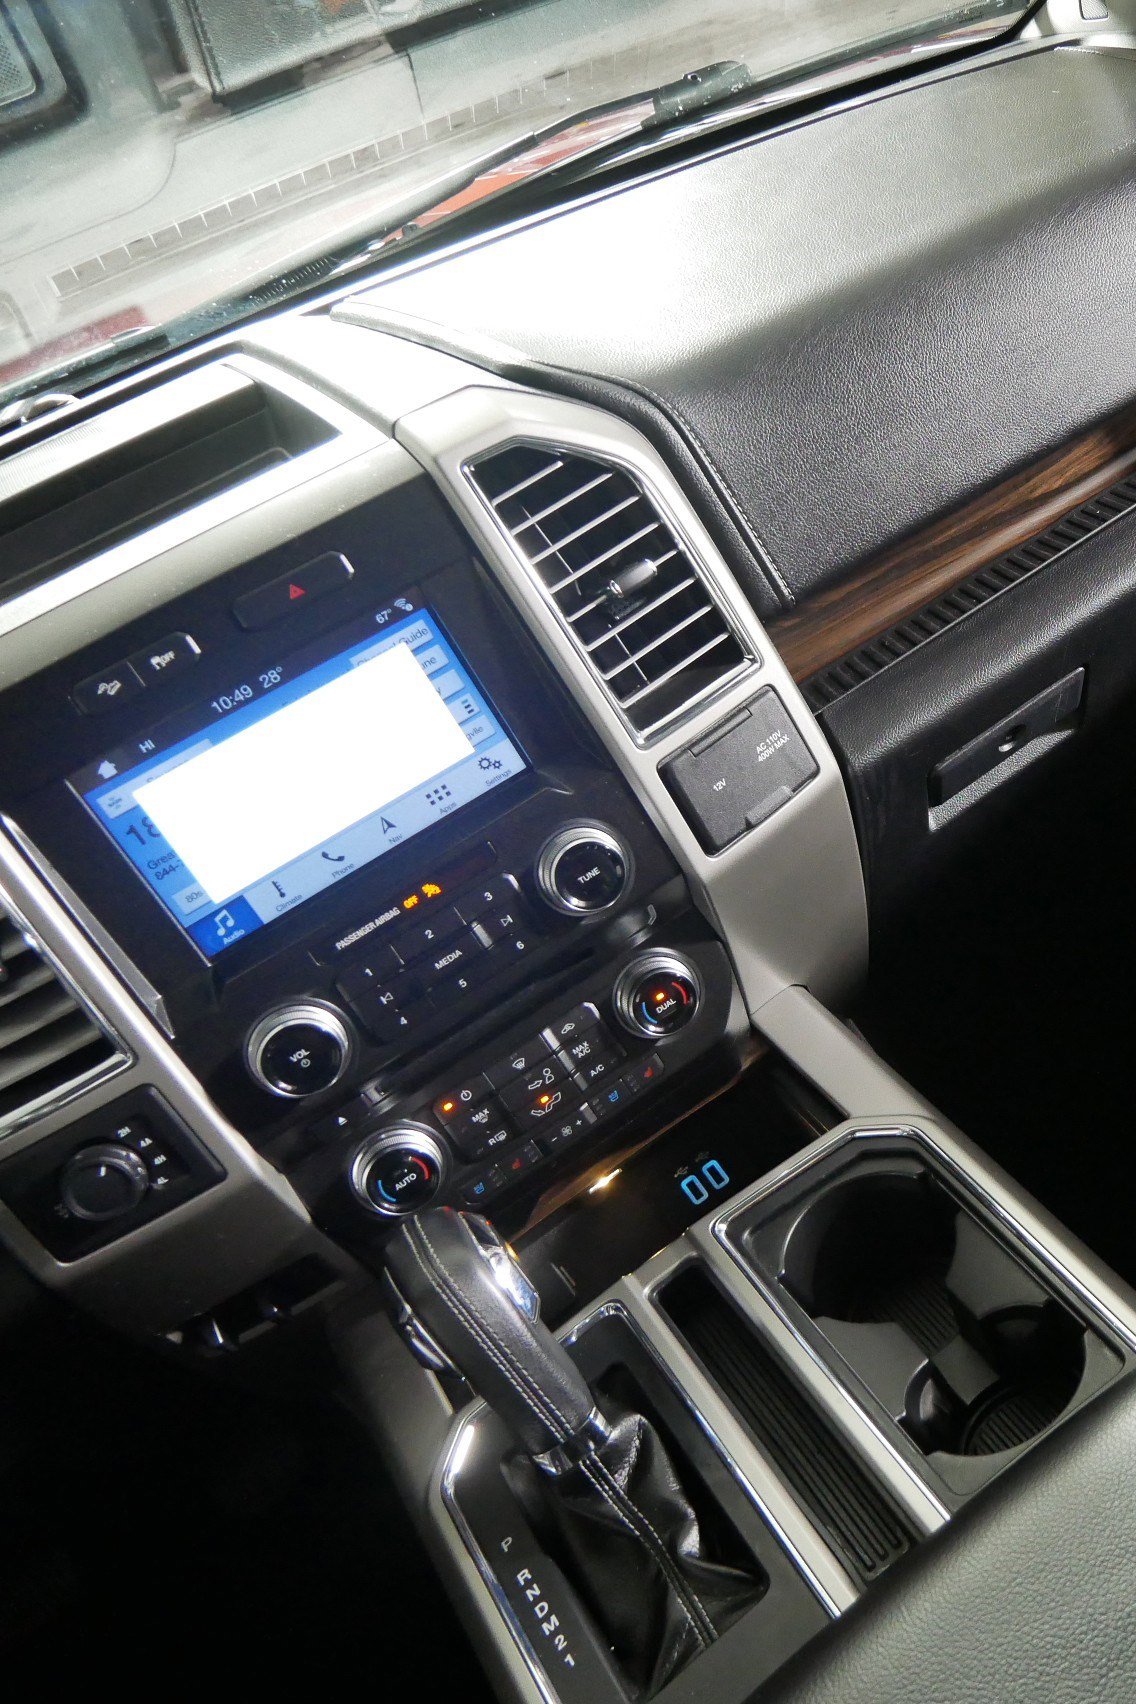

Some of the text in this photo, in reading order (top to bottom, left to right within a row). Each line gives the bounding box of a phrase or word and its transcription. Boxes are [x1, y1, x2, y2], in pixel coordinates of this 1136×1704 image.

[259, 666, 283, 689] 28°
[210, 684, 253, 713] 10:49
[138, 739, 155, 754] HI
[756, 729, 782, 754] AC 110V
[757, 733, 790, 762] 400W MAX
[484, 768, 512, 787] Settings
[713, 778, 726, 792] 12V
[439, 801, 457, 816] Apps
[388, 833, 403, 845] Nav
[331, 862, 355, 879] Phone
[577, 866, 600, 884] TUNE
[276, 893, 303, 912] Climate
[484, 891, 493, 901] 3
[335, 922, 376, 950] PASSENGER
[375, 907, 401, 927] AIRBAG
[425, 929, 435, 939] 2
[223, 929, 245, 945] Audio
[516, 940, 525, 950] 6
[434, 949, 462, 970] MEDIA
[364, 968, 373, 977] 1
[458, 978, 467, 988] 5
[655, 998, 677, 1014] DUAL
[400, 1016, 408, 1025] 4
[289, 1048, 310, 1063] VOL
[572, 1041, 590, 1055] MAX
[578, 1046, 591, 1058] A/C
[590, 1064, 605, 1077] A/C
[472, 1108, 490, 1122] MAX
[488, 1138, 496, 1146] R
[395, 1172, 417, 1191] AUTO
[501, 1537, 512, 1552] P
[516, 1568, 532, 1586] R
[525, 1583, 541, 1602] N
[534, 1601, 549, 1619] D
[541, 1614, 560, 1636] M
[554, 1634, 568, 1650] 2
[564, 1653, 575, 1667] 1
